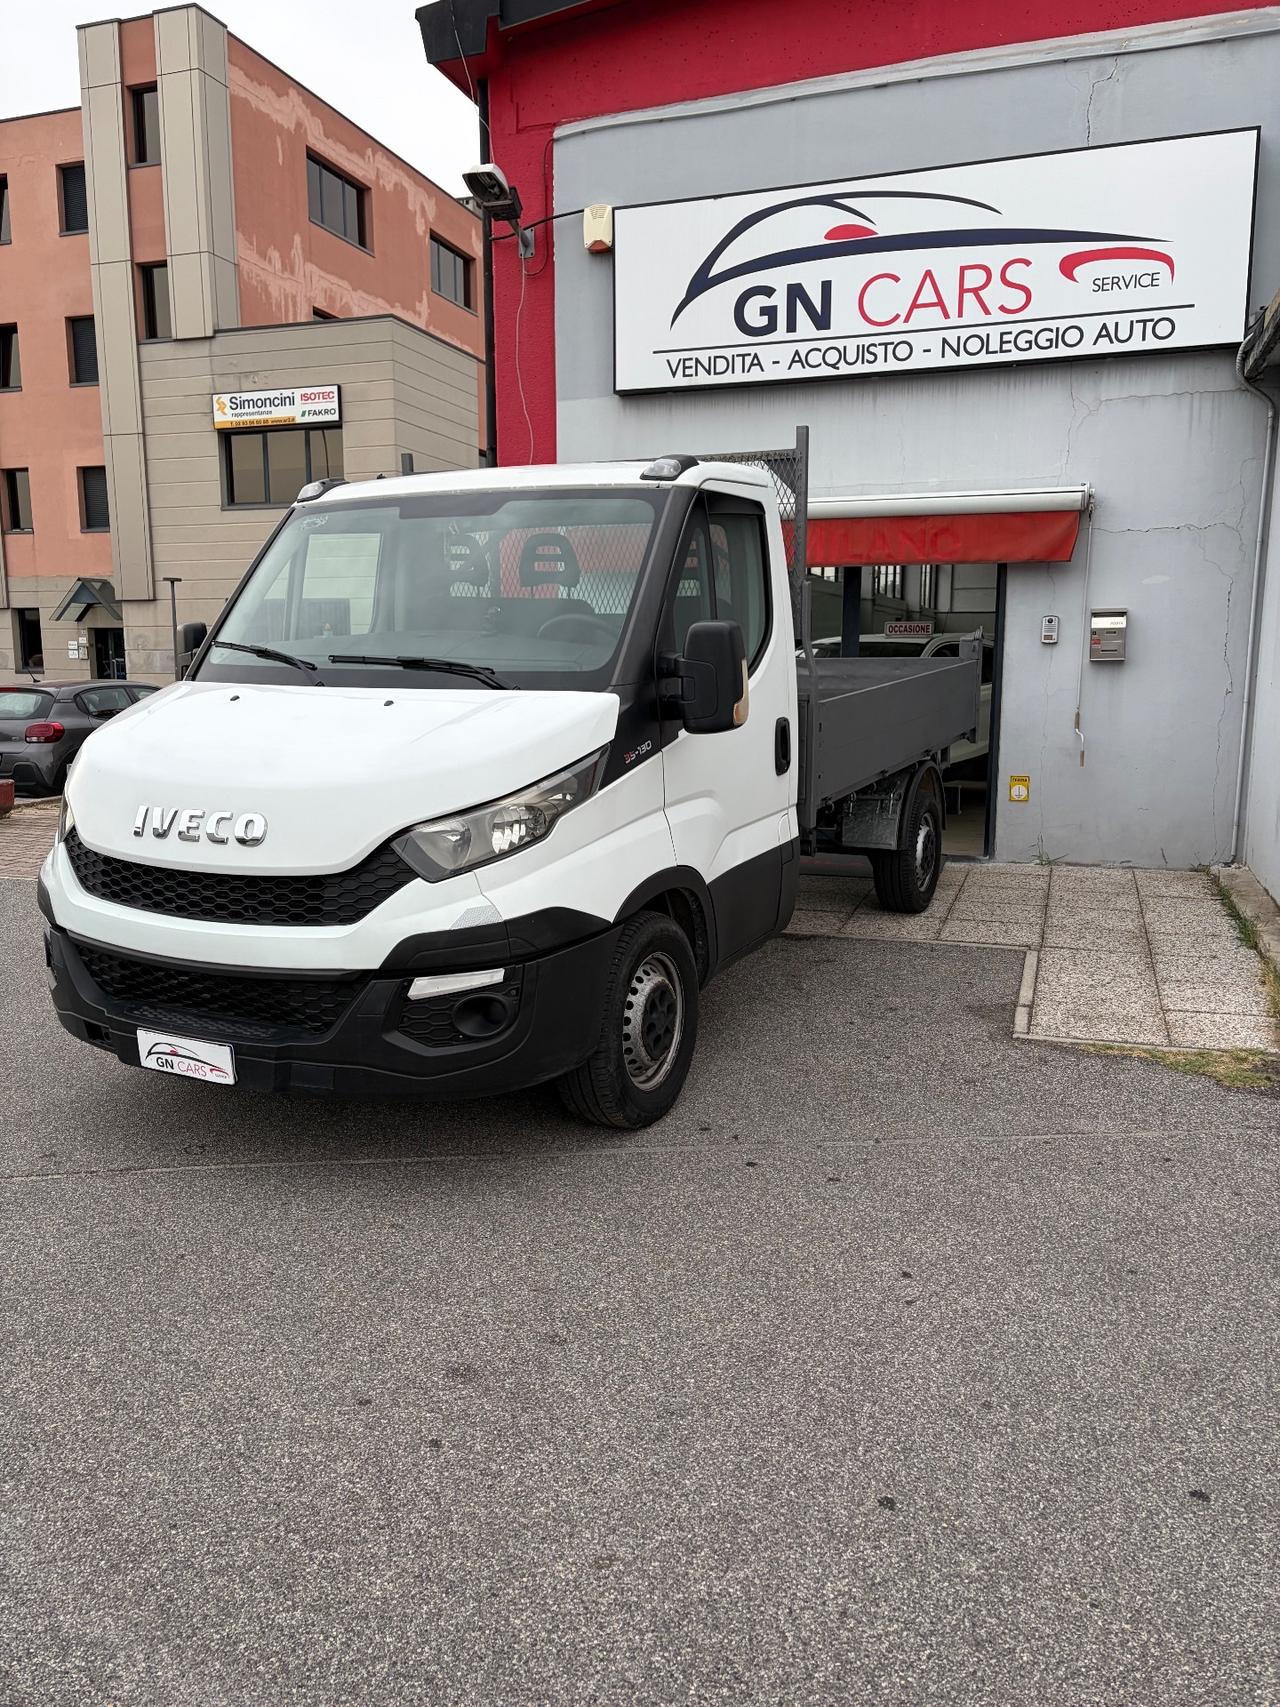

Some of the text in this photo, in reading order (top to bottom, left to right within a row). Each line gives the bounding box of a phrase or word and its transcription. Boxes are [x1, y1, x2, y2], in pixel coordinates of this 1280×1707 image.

[1092, 272, 1160, 292] SERVICE
[734, 258, 1032, 337] GN CARS
[666, 353, 765, 378] VENDITA
[787, 341, 914, 370] ACQUISTO
[941, 325, 1085, 358] NOLEGGIO
[1092, 317, 1176, 345] AUTO
[229, 392, 295, 410] Simoncini
[300, 391, 335, 401] ISOTEC
[307, 408, 336, 417] FAKRO
[888, 624, 931, 633] OCCASIONE
[623, 740, 652, 764] 35-130
[133, 804, 268, 848] IVECO
[156, 1056, 207, 1077] GN CARS
